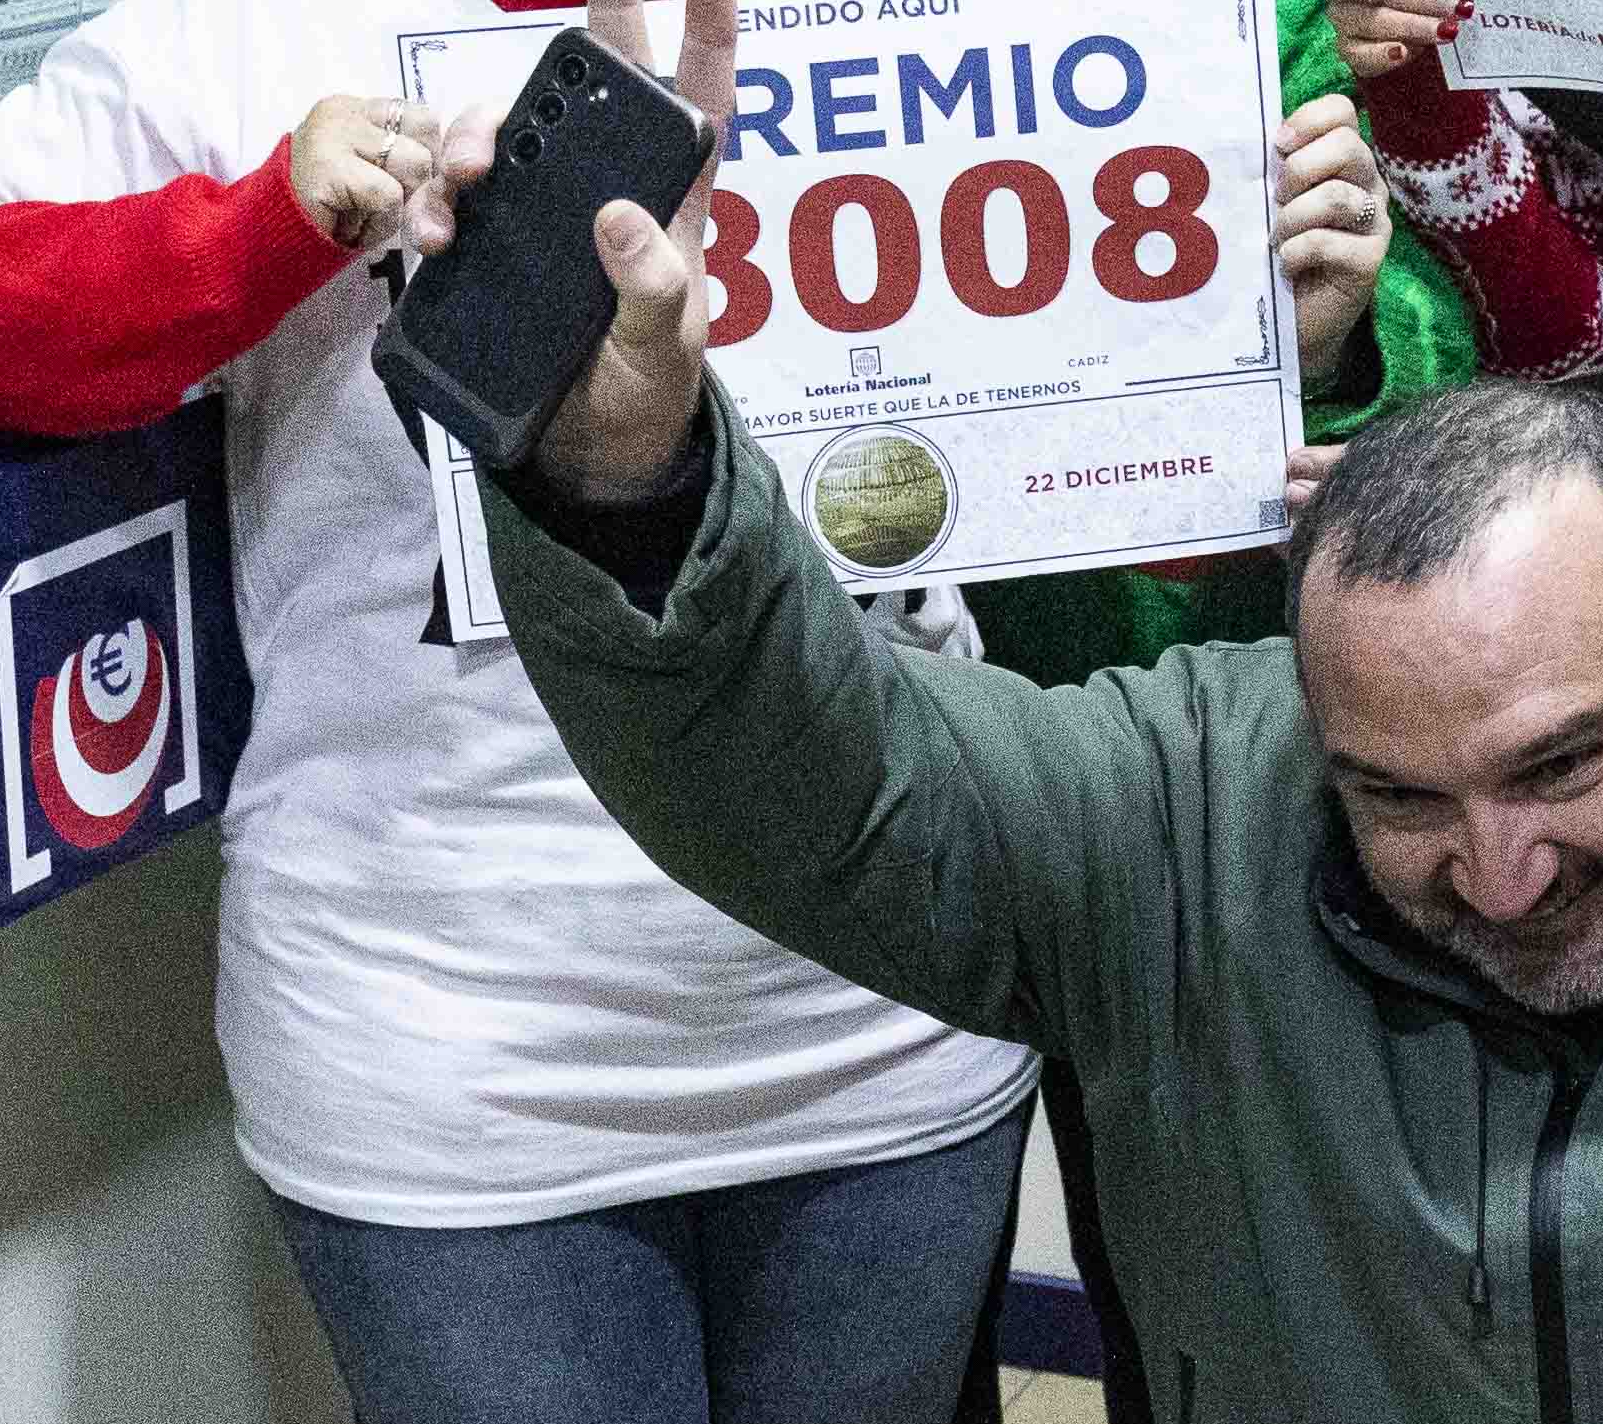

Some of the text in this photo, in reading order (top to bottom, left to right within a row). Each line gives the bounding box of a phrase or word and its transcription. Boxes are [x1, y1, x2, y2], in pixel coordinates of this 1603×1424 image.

[736, 0, 864, 33] ENDIDO
[722, 34, 1148, 162] REMIO
[1068, 355, 1110, 368] CADIZ
[805, 372, 932, 399] Lotería Nacional
[809, 402, 878, 423] SUERTE
[884, 397, 921, 414] QUE
[927, 393, 951, 409] LA
[956, 390, 980, 406] DE
[985, 380, 1082, 402] TENERNOS
[1025, 455, 1215, 493] 22 DICIEMBRE
